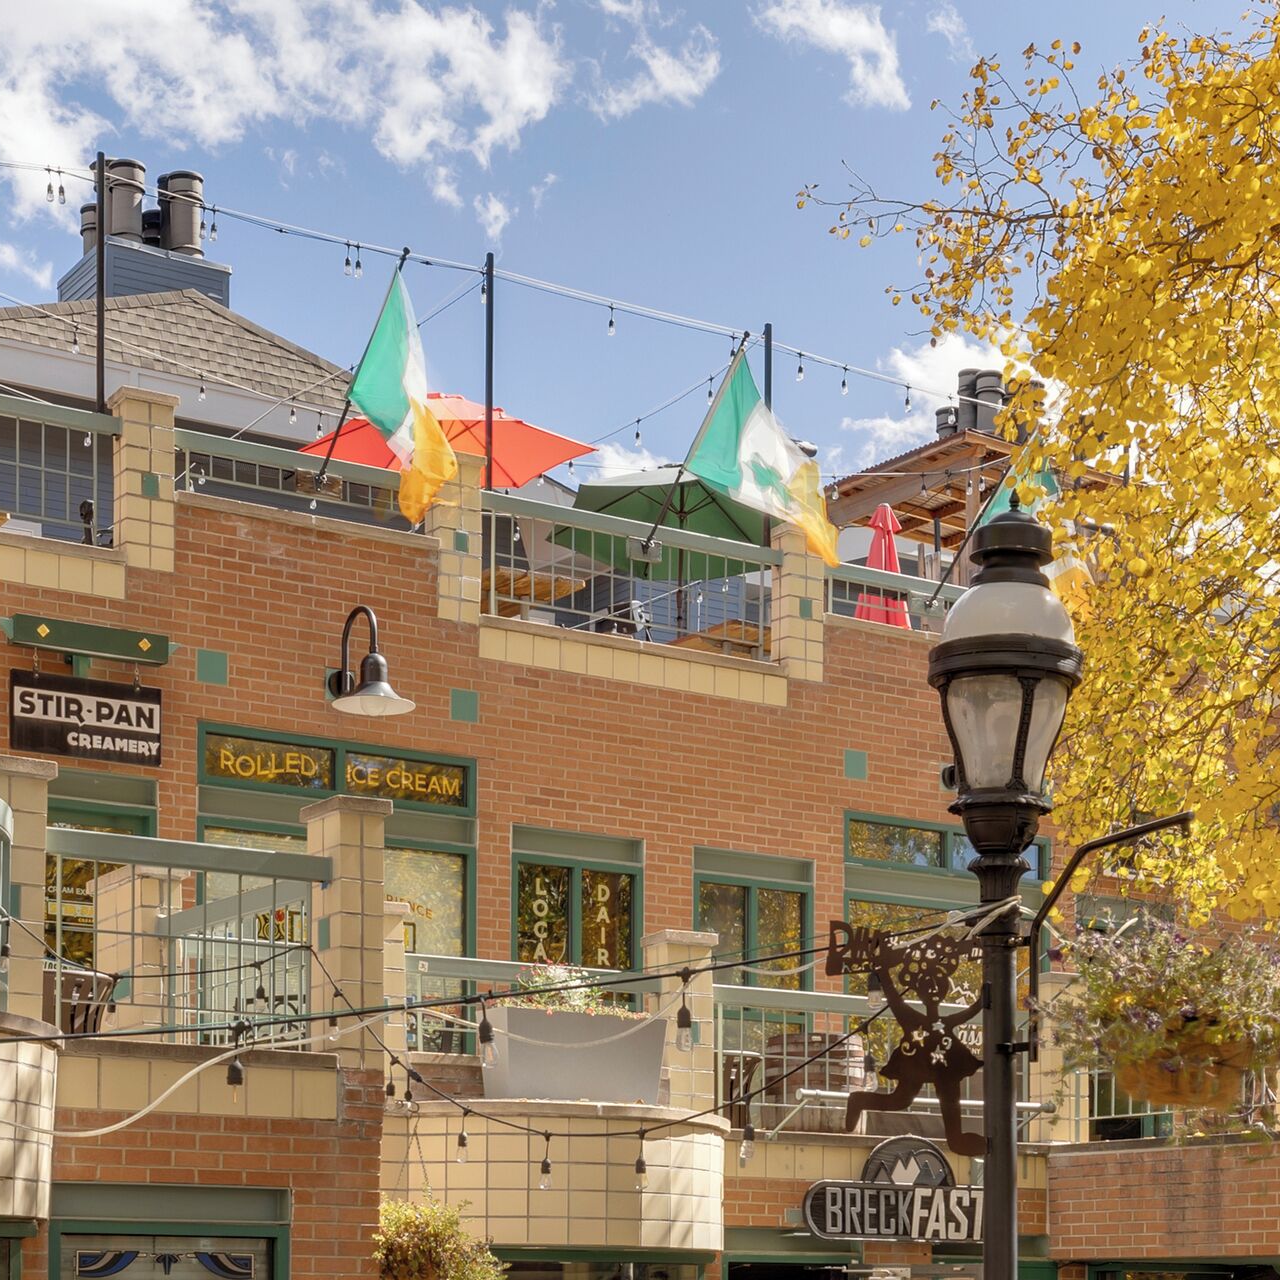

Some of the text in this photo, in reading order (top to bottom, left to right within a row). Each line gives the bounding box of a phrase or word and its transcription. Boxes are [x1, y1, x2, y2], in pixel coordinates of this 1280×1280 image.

[19, 690, 155, 729] STIR-PAN
[66, 731, 160, 757] CREAMERY
[220, 749, 461, 797] ROLLED ICE CREAM
[47, 885, 74, 895] CRAM
[825, 1187, 984, 1241] BRECKFAST
